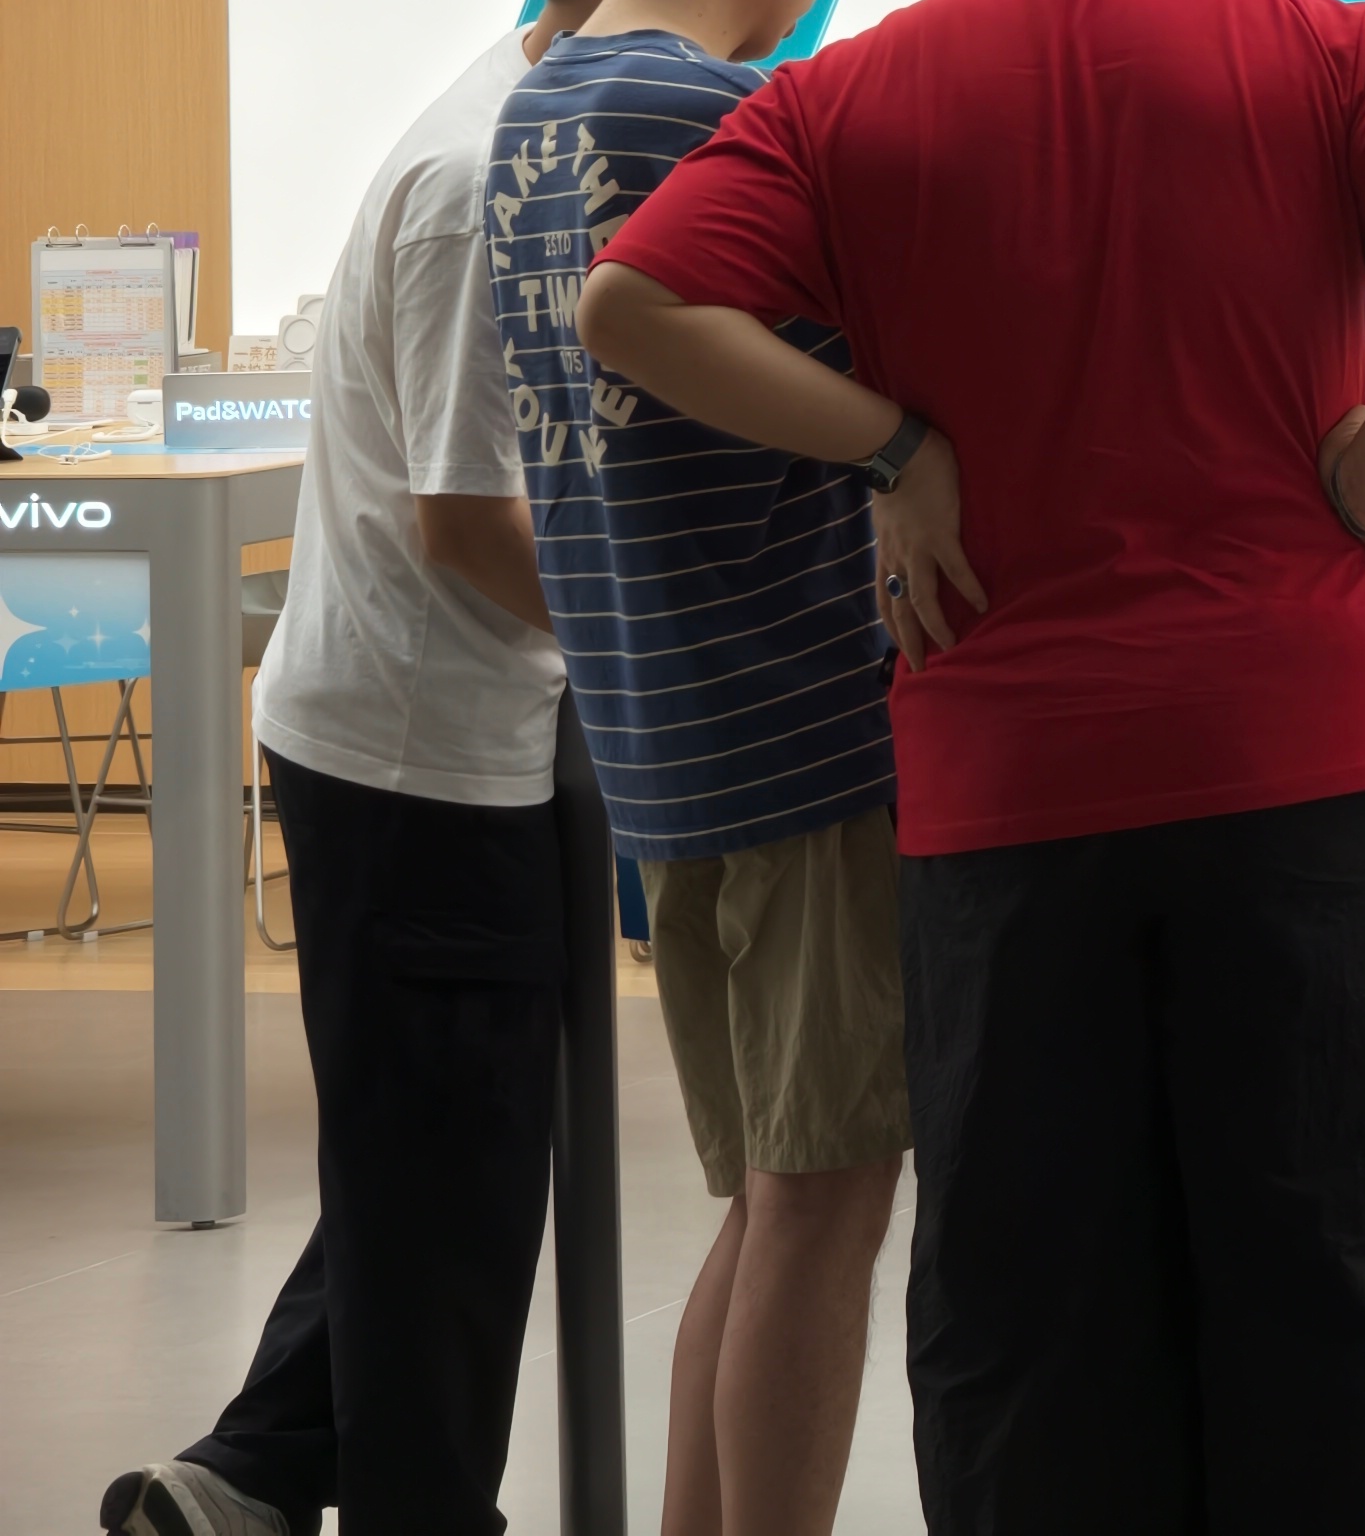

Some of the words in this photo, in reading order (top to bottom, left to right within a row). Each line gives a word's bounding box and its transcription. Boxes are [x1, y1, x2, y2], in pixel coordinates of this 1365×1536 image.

[519, 275, 586, 333] TIM
[176, 399, 312, 422] Pad&WATC
[0, 493, 112, 528] vivo
